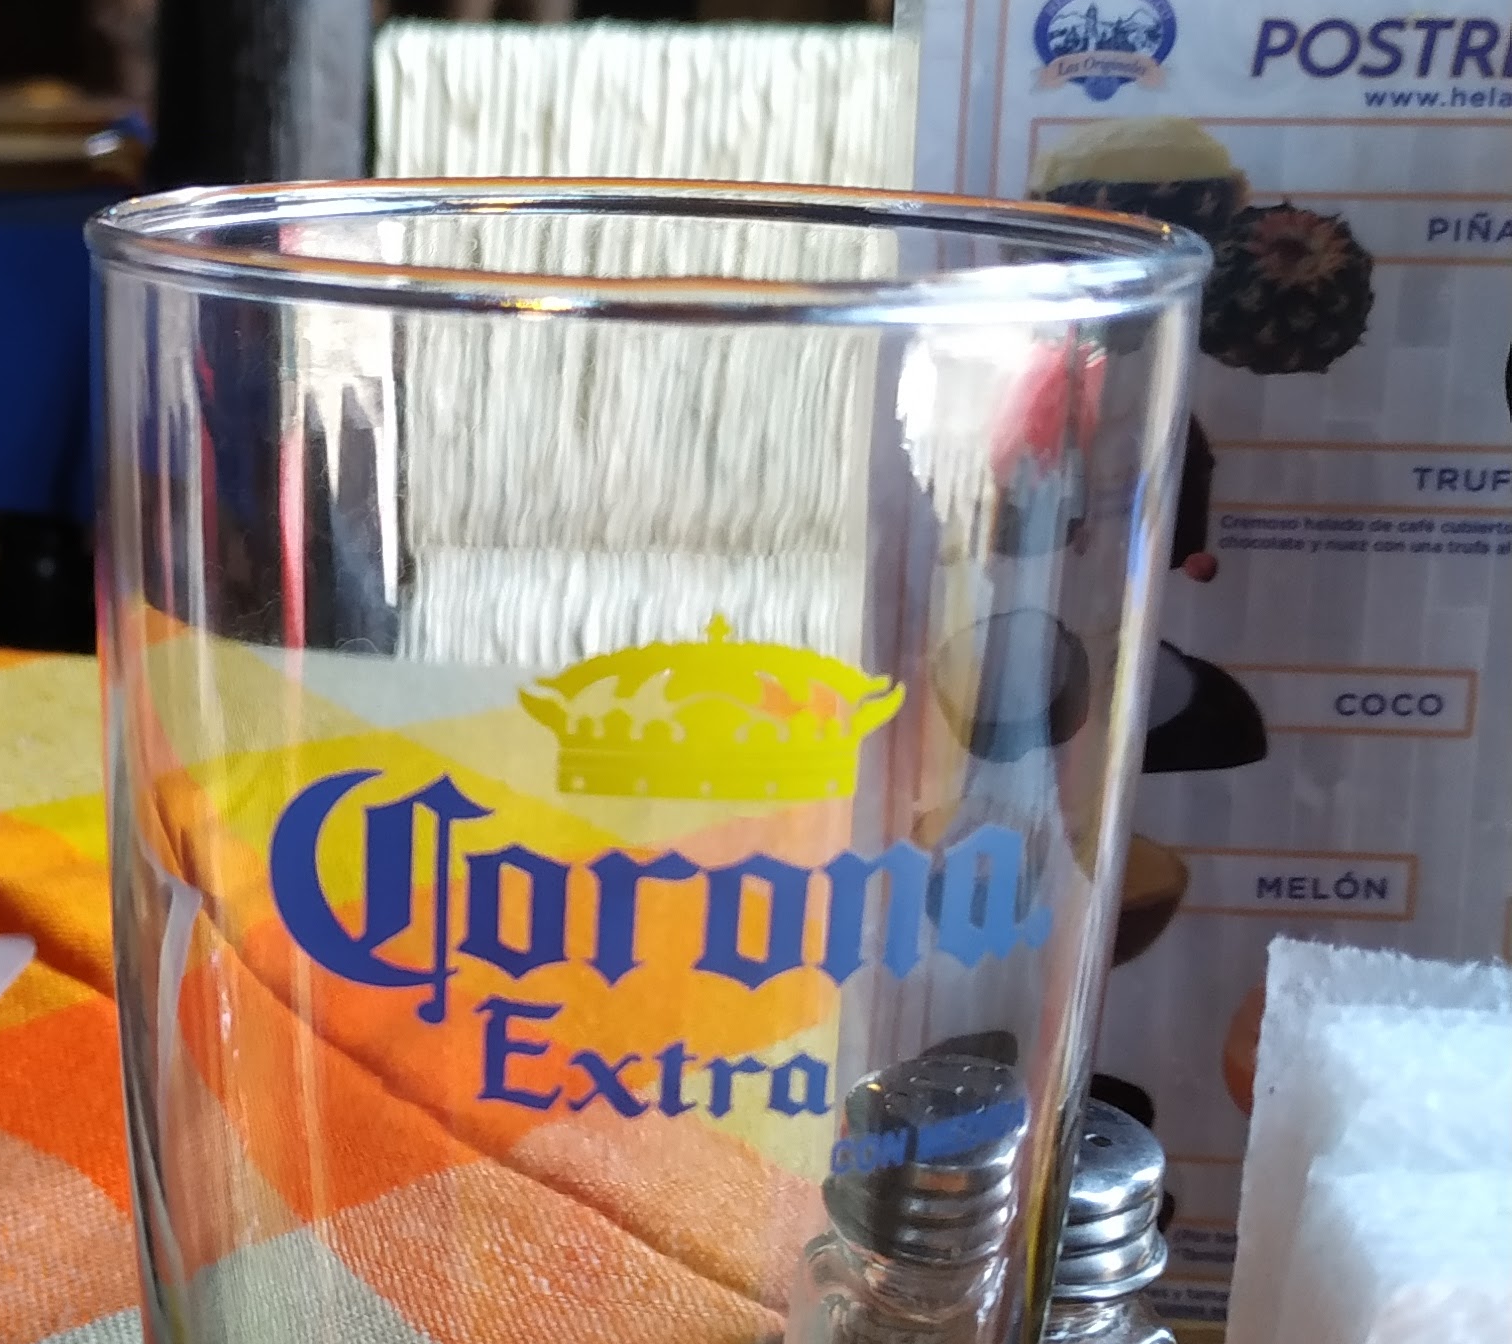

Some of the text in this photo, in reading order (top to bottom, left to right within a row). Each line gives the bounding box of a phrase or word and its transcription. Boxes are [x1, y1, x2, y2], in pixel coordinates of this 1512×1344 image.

[1335, 693, 1444, 718] COCO
[270, 768, 1054, 1024] Corona
[1256, 870, 1389, 901] MELÓN
[475, 997, 835, 1119] Extra
